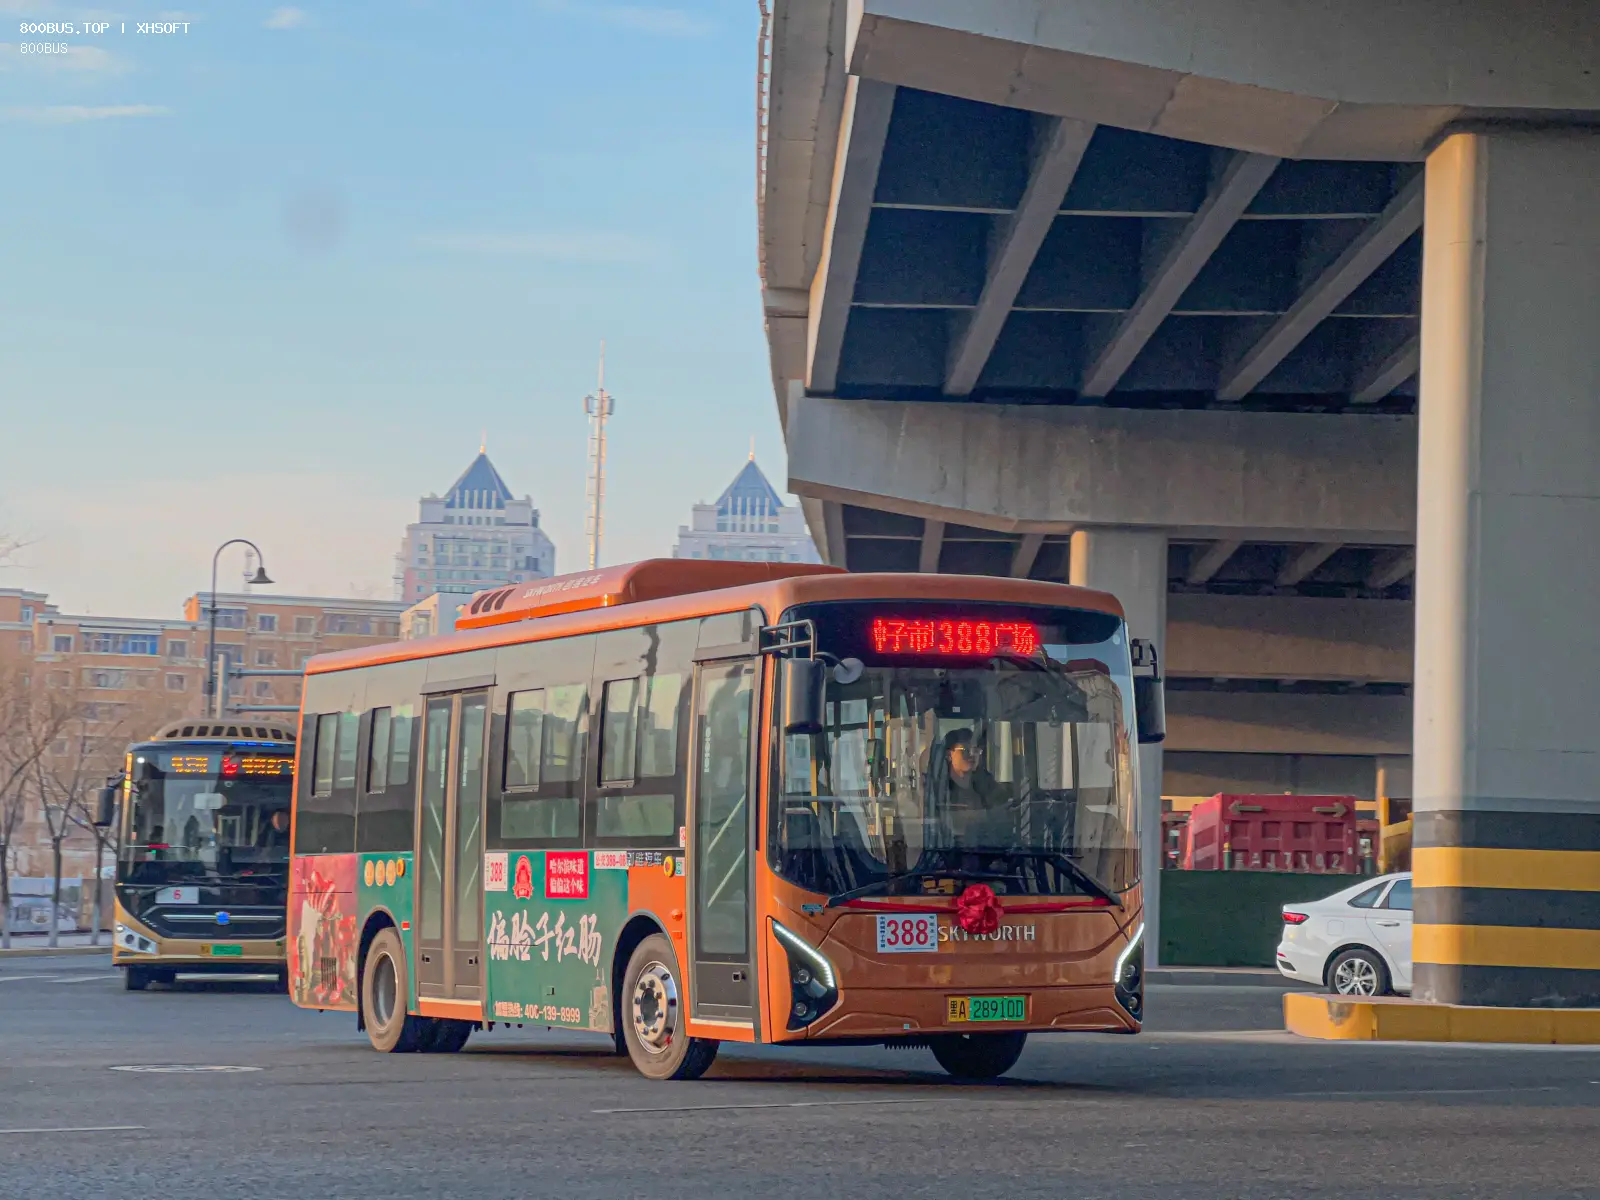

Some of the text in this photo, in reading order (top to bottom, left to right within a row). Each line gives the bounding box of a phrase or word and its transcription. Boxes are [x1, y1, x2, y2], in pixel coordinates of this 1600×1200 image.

[490, 862, 503, 882] 388
[549, 858, 584, 874] 哈尔滨味道
[550, 877, 584, 894] 偏偏这个味
[487, 909, 602, 967] 偏脸子红肠
[887, 919, 928, 946] 388
